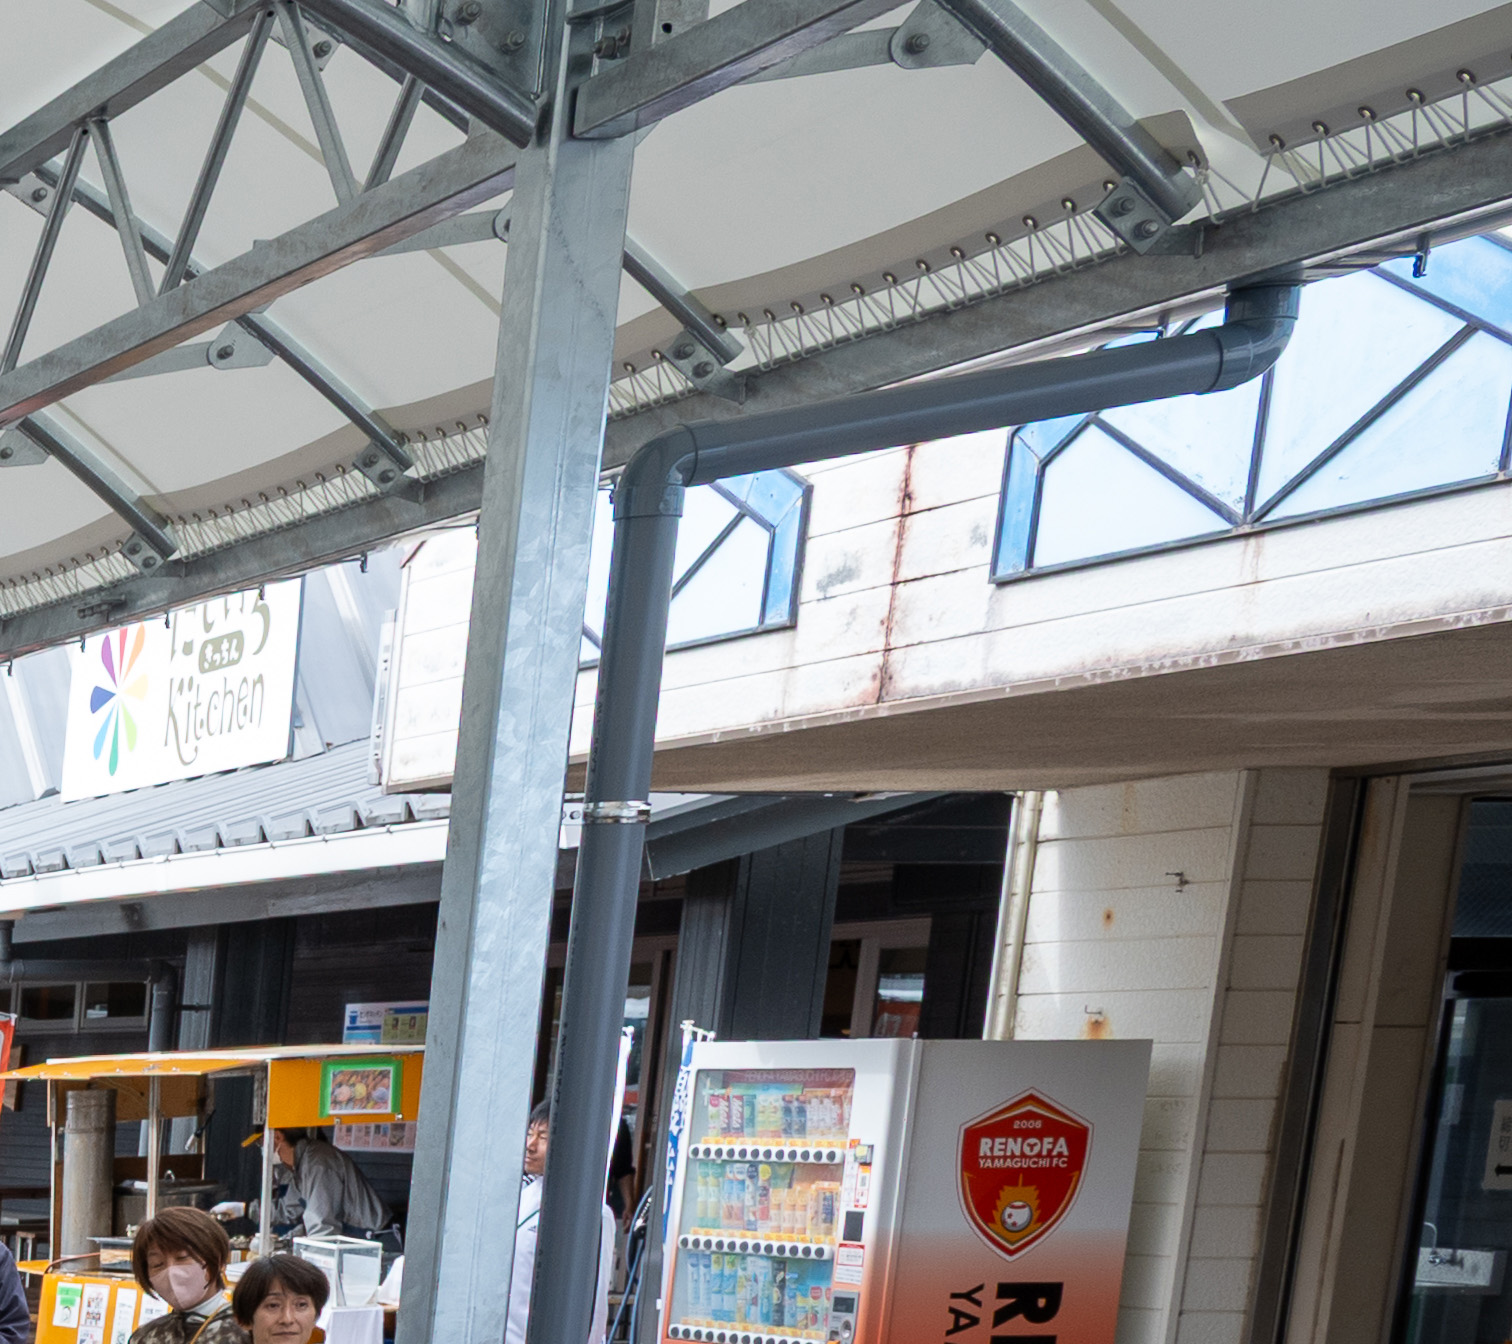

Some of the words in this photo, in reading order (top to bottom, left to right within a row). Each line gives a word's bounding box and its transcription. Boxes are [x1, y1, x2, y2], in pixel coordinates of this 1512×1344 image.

[203, 637, 240, 670] きっちん
[164, 672, 264, 767] Kitchen
[978, 1136, 1070, 1158] RENOFA
[978, 1157, 1050, 1168] YAMAGUCHI
[1052, 1157, 1068, 1168] FC
